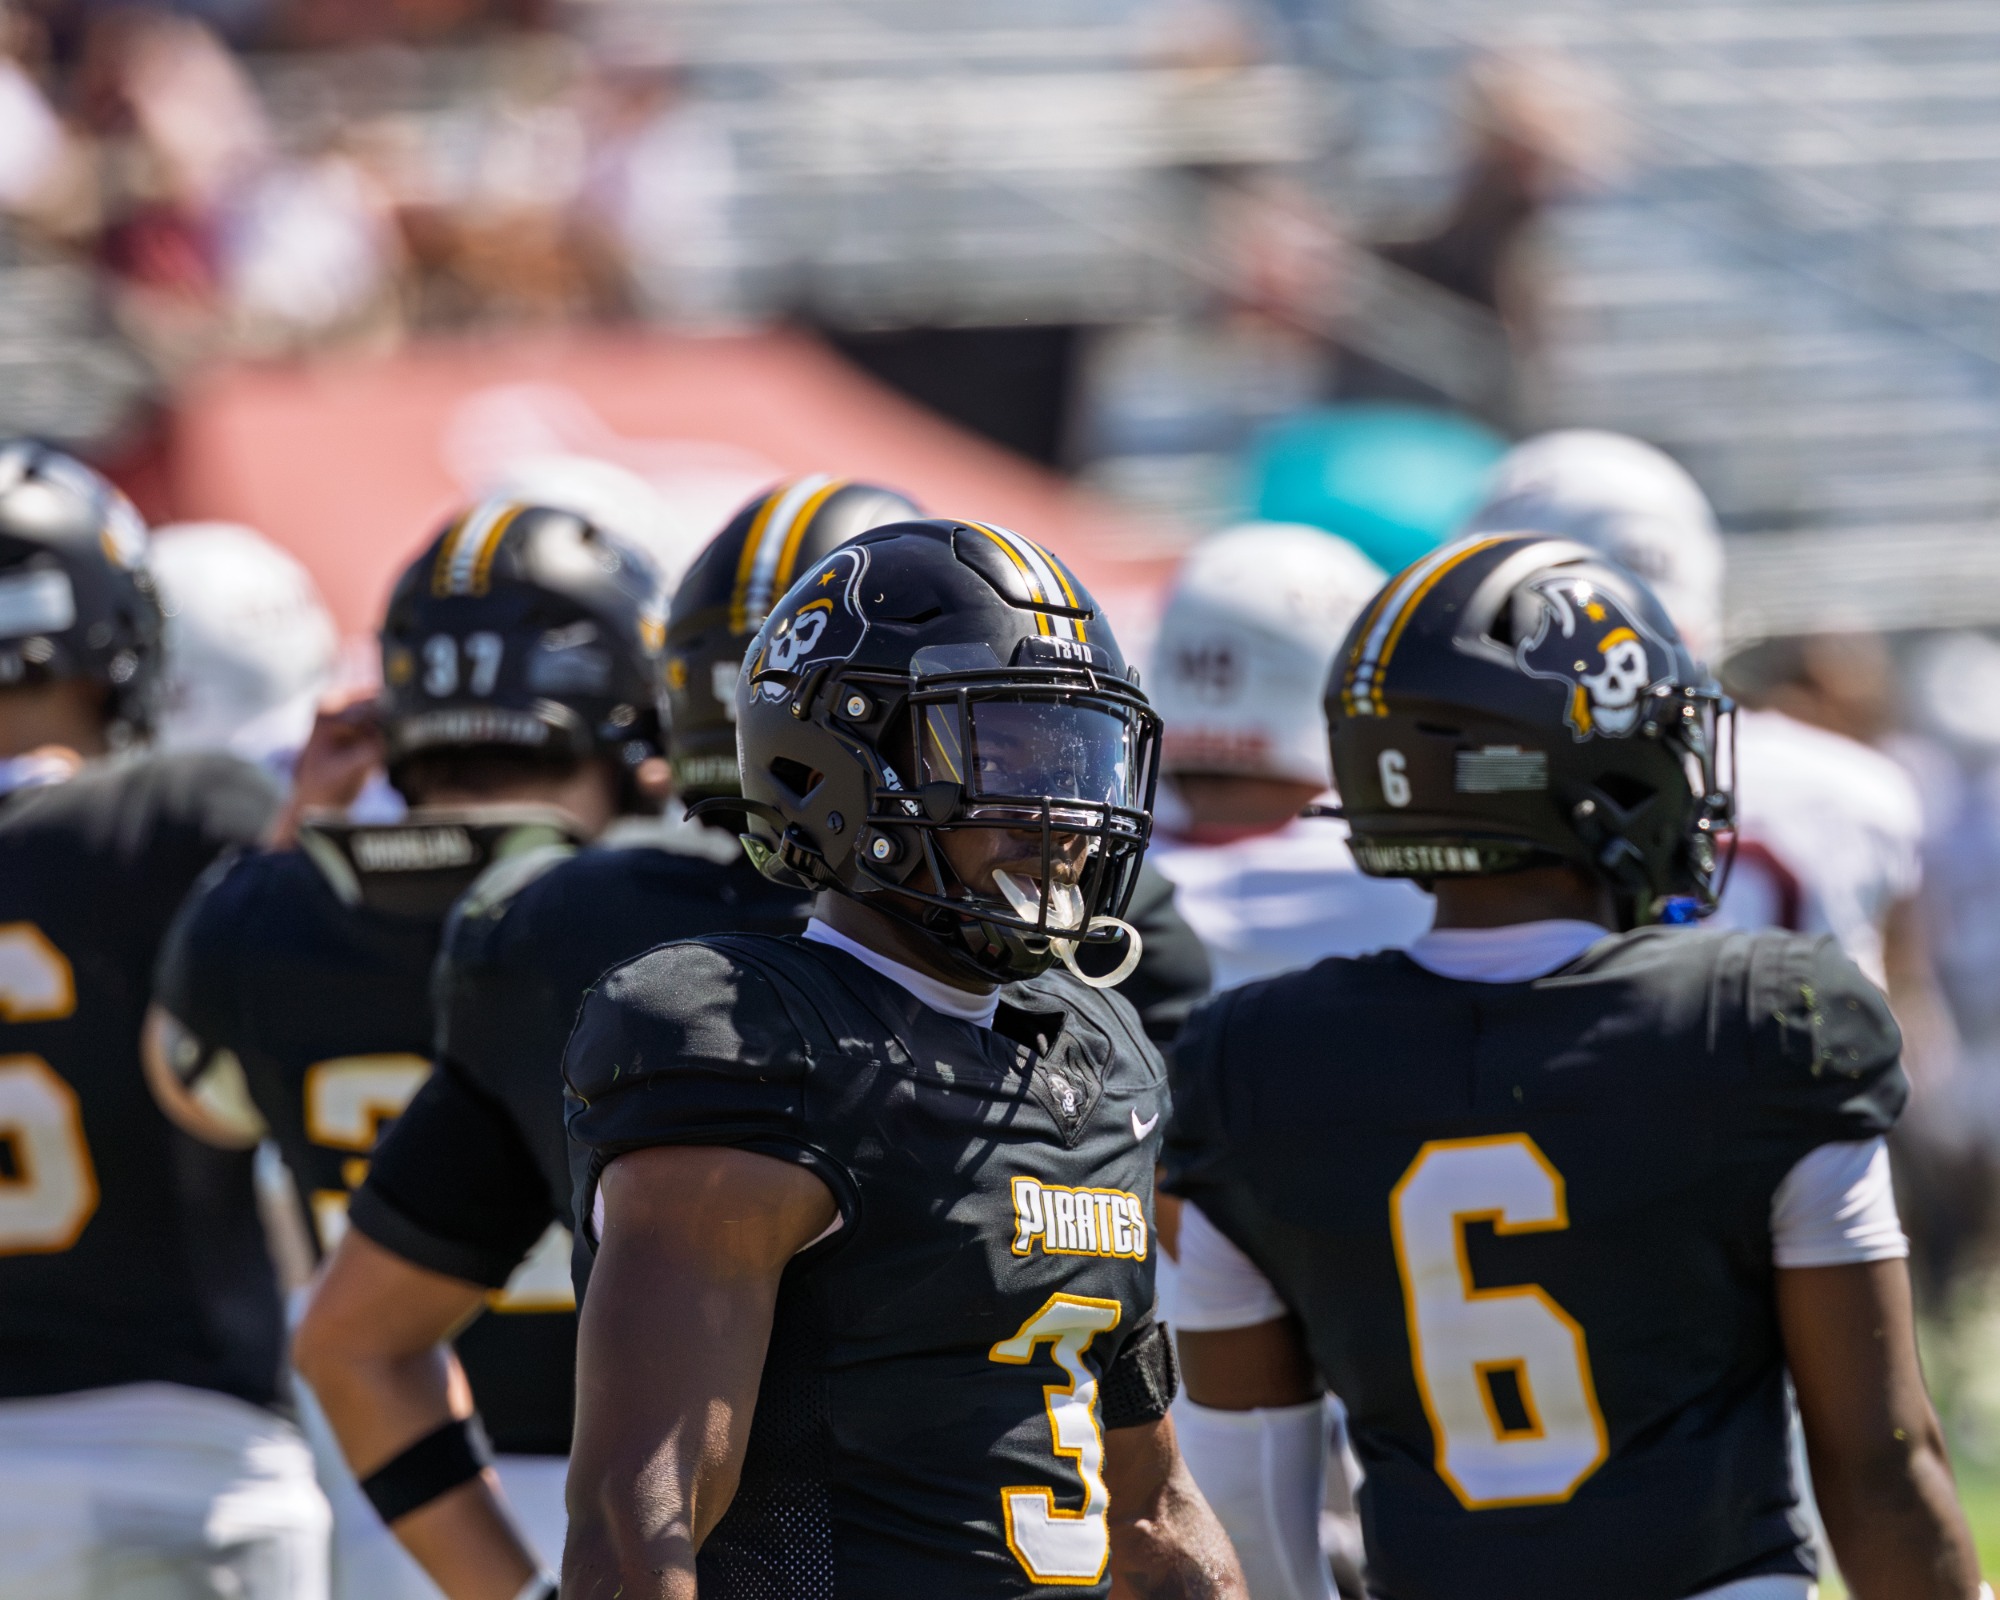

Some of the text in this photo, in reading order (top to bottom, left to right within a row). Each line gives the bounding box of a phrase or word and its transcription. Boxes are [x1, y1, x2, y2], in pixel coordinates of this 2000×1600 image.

[422, 632, 503, 697] 37
[1053, 641, 1093, 664] 1840
[1377, 748, 1413, 808] 6
[1011, 1175, 1147, 1263] PIRATES
[1389, 1132, 1610, 1511] 6
[989, 1292, 1122, 1586] 3
